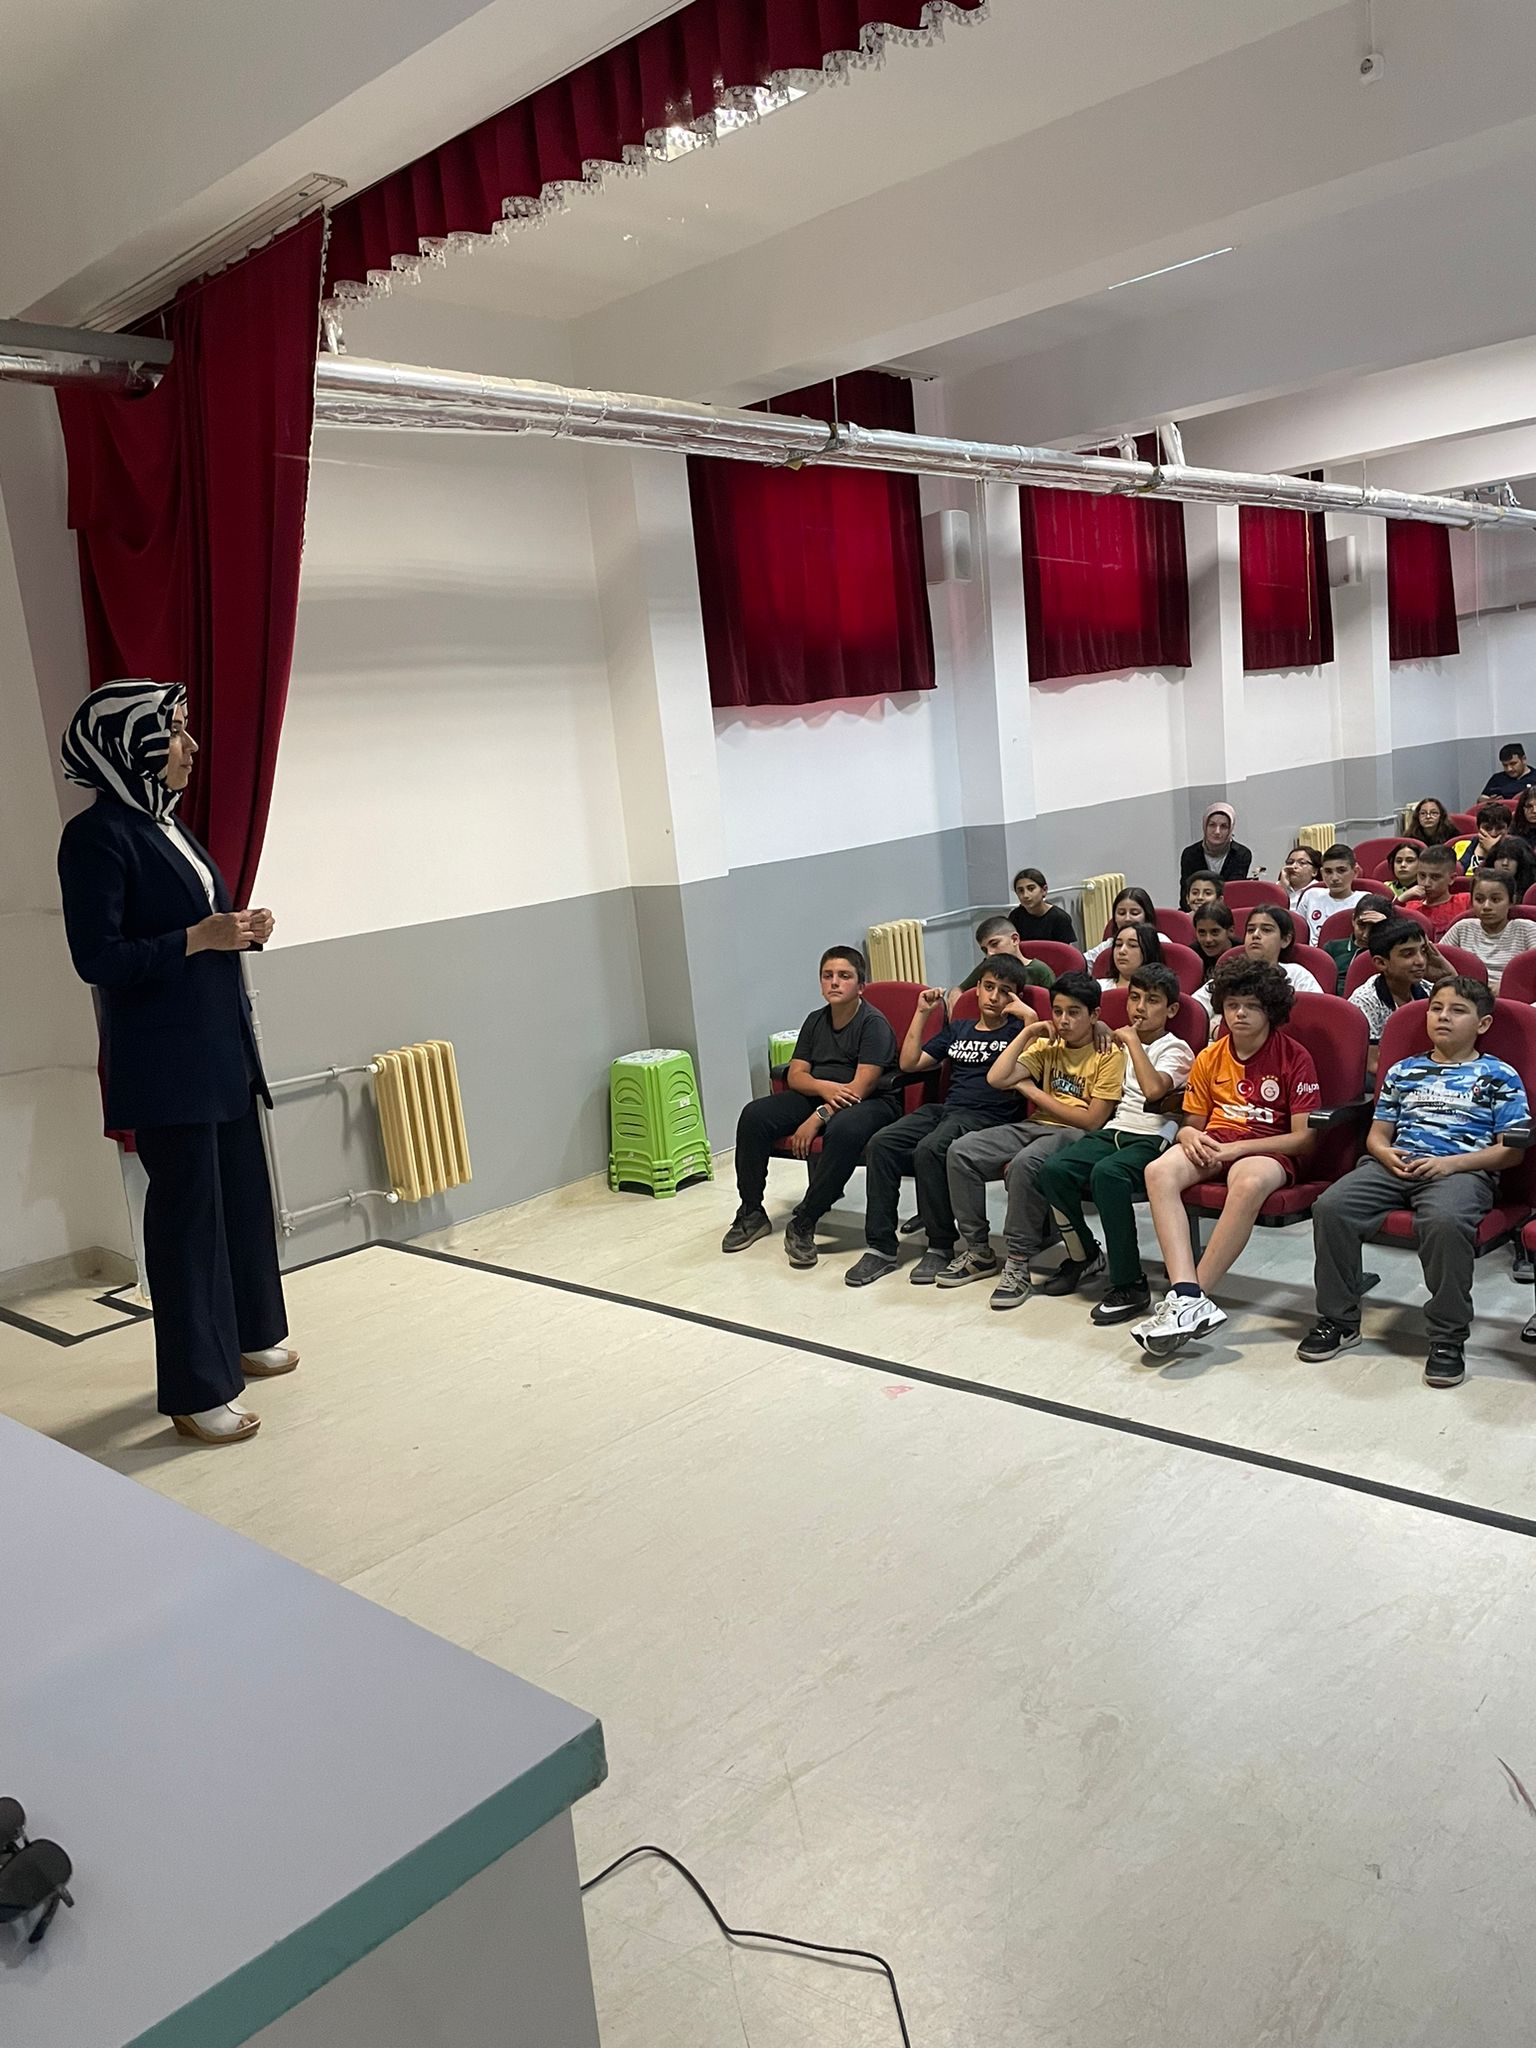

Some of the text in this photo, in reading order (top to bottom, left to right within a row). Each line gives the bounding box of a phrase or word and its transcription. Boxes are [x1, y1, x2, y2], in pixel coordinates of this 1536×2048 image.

[949, 1040, 1008, 1051] SKATE OF
[947, 1048, 979, 1059] MIND
